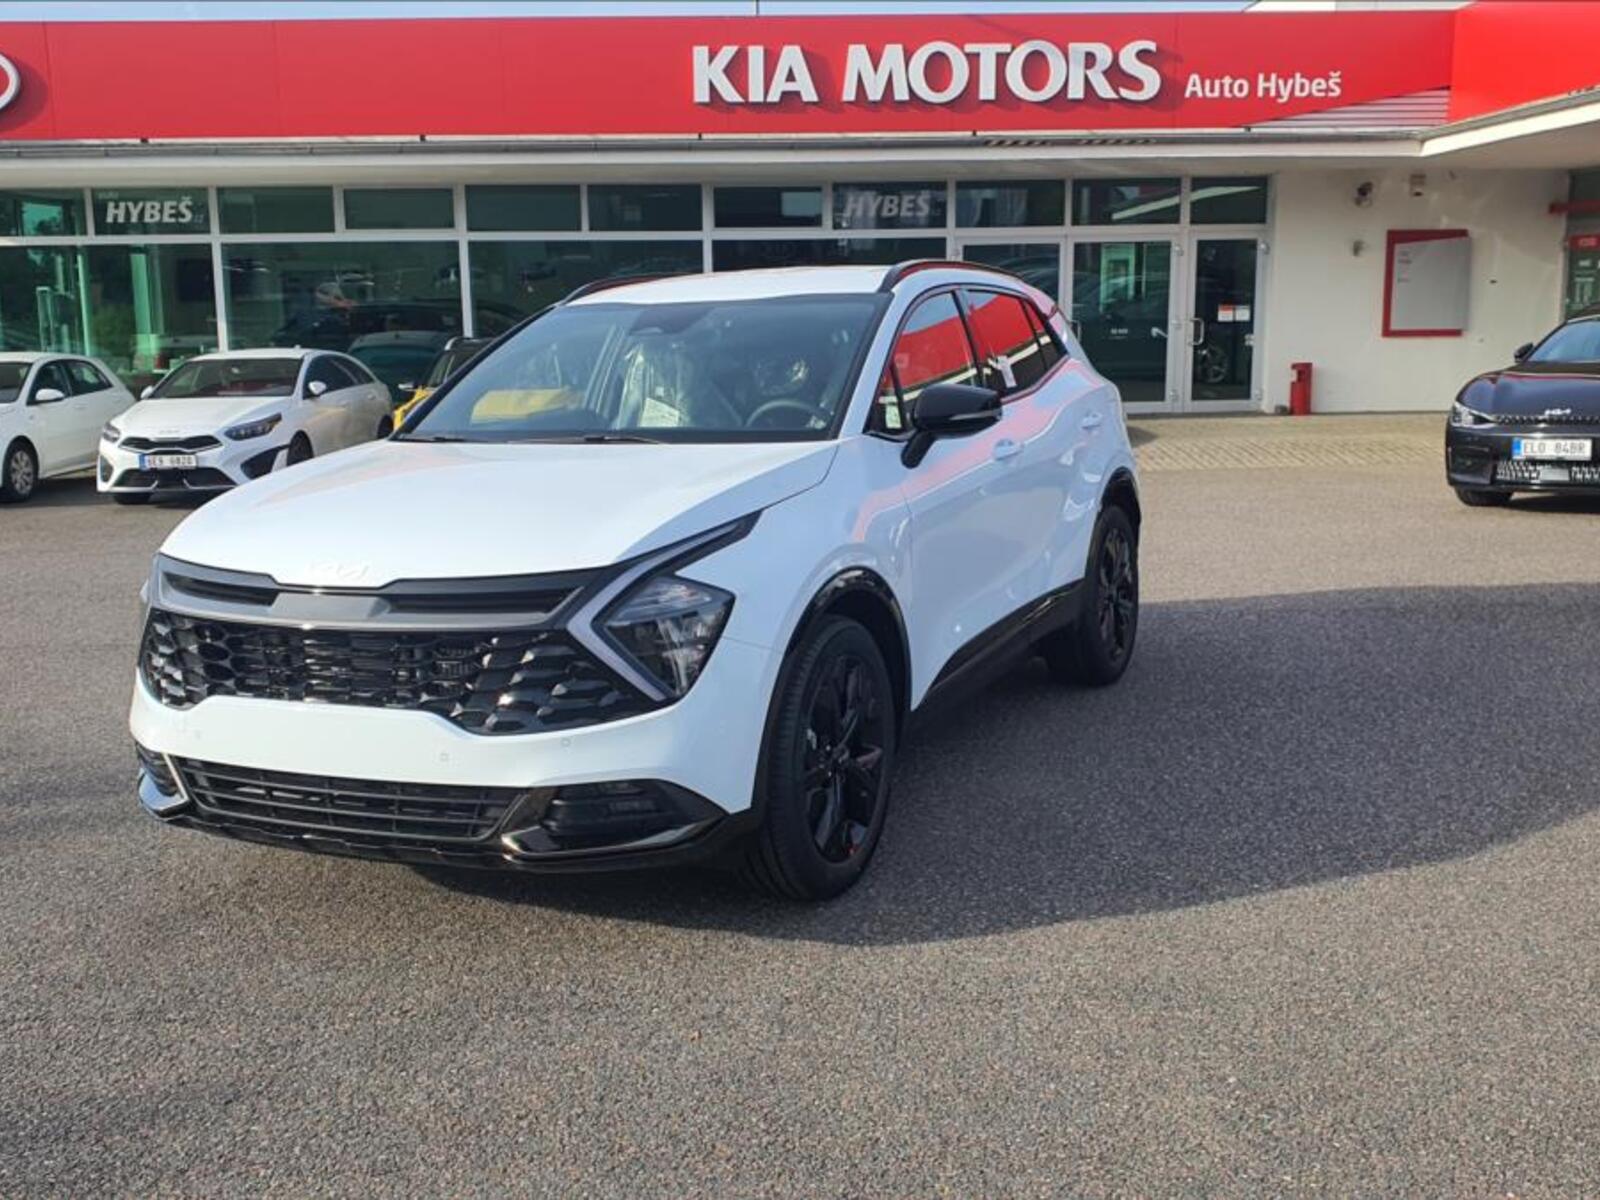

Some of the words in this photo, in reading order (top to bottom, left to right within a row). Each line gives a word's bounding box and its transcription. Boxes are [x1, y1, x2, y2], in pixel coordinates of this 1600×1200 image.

[692, 44, 819, 104] KIA
[842, 39, 1161, 104] MOTORS
[1184, 73, 1249, 98] Auto
[1257, 71, 1342, 103] Hybeš
[105, 196, 193, 223] HYBEŠ
